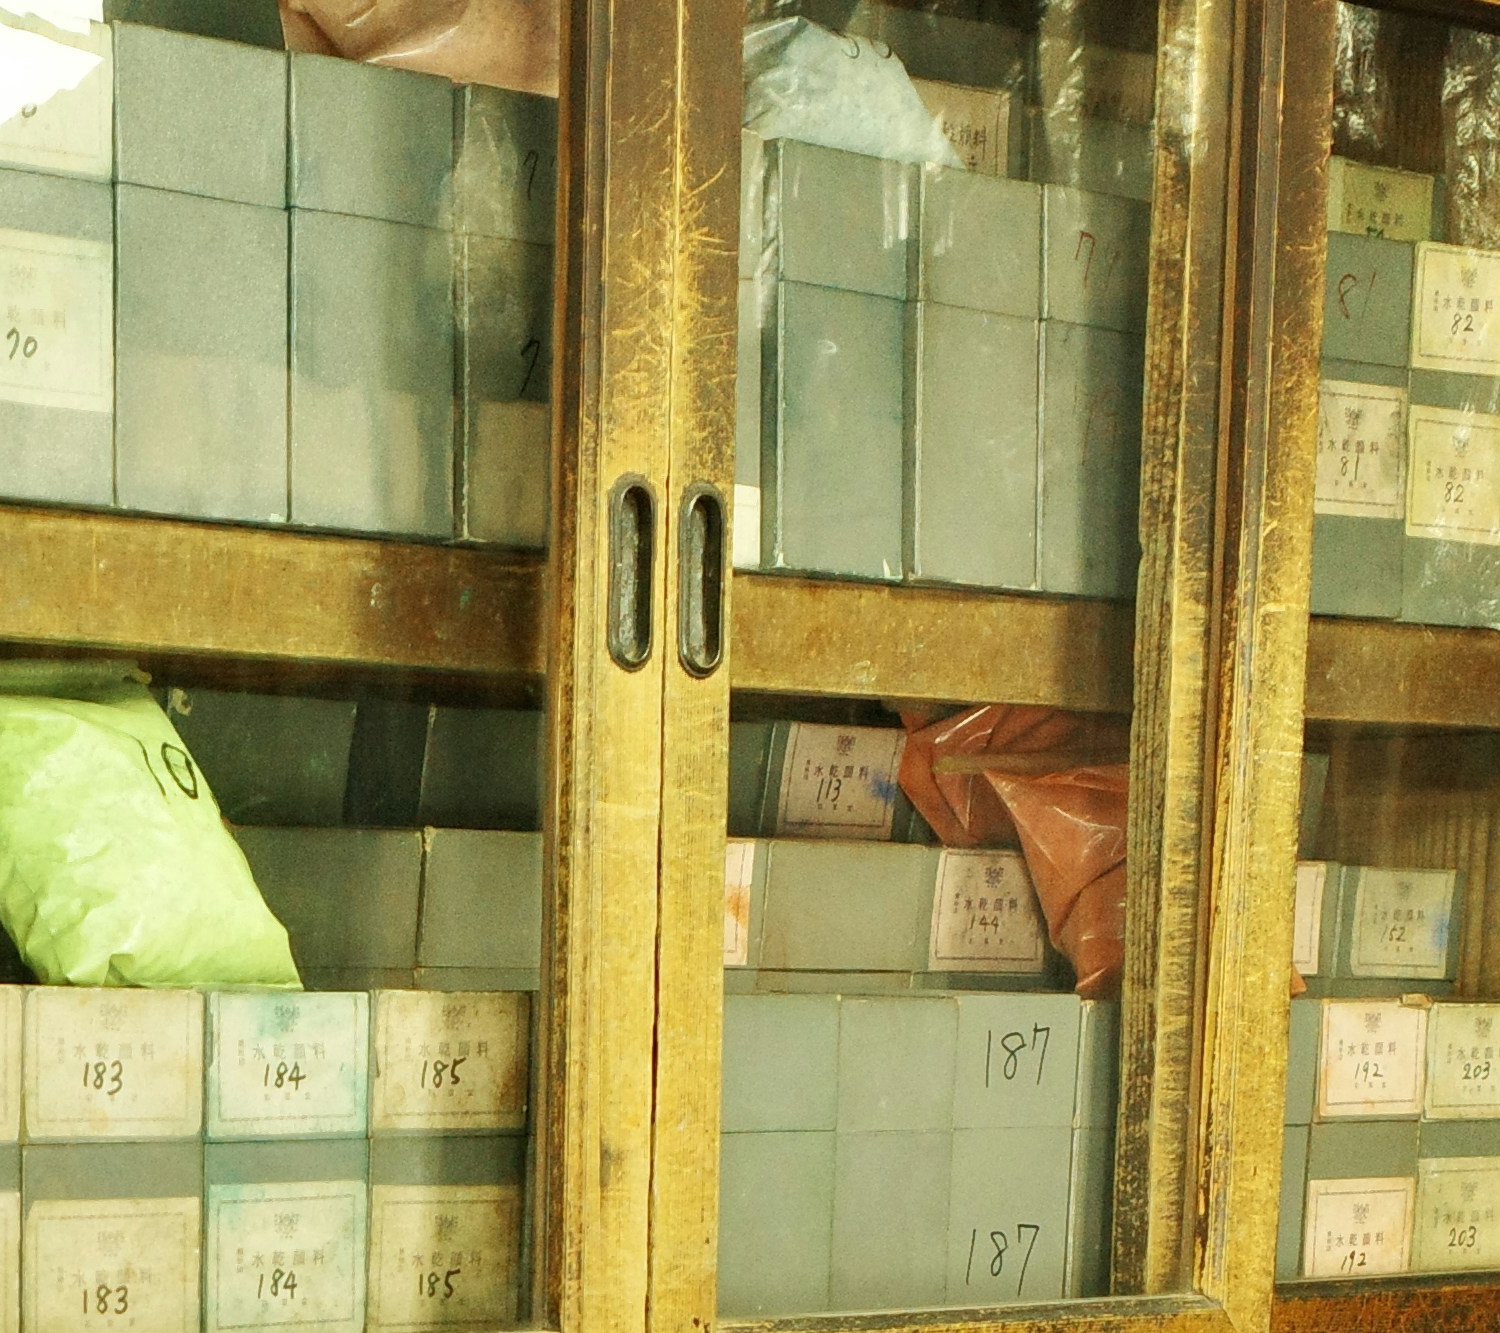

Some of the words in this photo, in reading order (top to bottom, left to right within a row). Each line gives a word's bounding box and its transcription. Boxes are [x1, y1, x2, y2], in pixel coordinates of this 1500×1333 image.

[1450, 312, 1474, 336] 82
[1340, 453, 1359, 482] 81
[1444, 482, 1463, 503] 82
[816, 778, 842, 803] 113
[970, 915, 1000, 934] 144
[1380, 925, 1407, 944] 152
[982, 1025, 1051, 1091] 187
[1354, 1061, 1384, 1081] 192
[1461, 1061, 1491, 1081] 203
[83, 1060, 124, 1097] 183
[263, 1062, 307, 1091] 184
[421, 1057, 467, 1089] 185
[1448, 1226, 1477, 1247] 203
[966, 1223, 1039, 1296] 187
[1340, 1251, 1368, 1274] 192
[257, 1269, 299, 1300] 184
[418, 1267, 462, 1299] 185
[82, 1285, 130, 1317] 183
